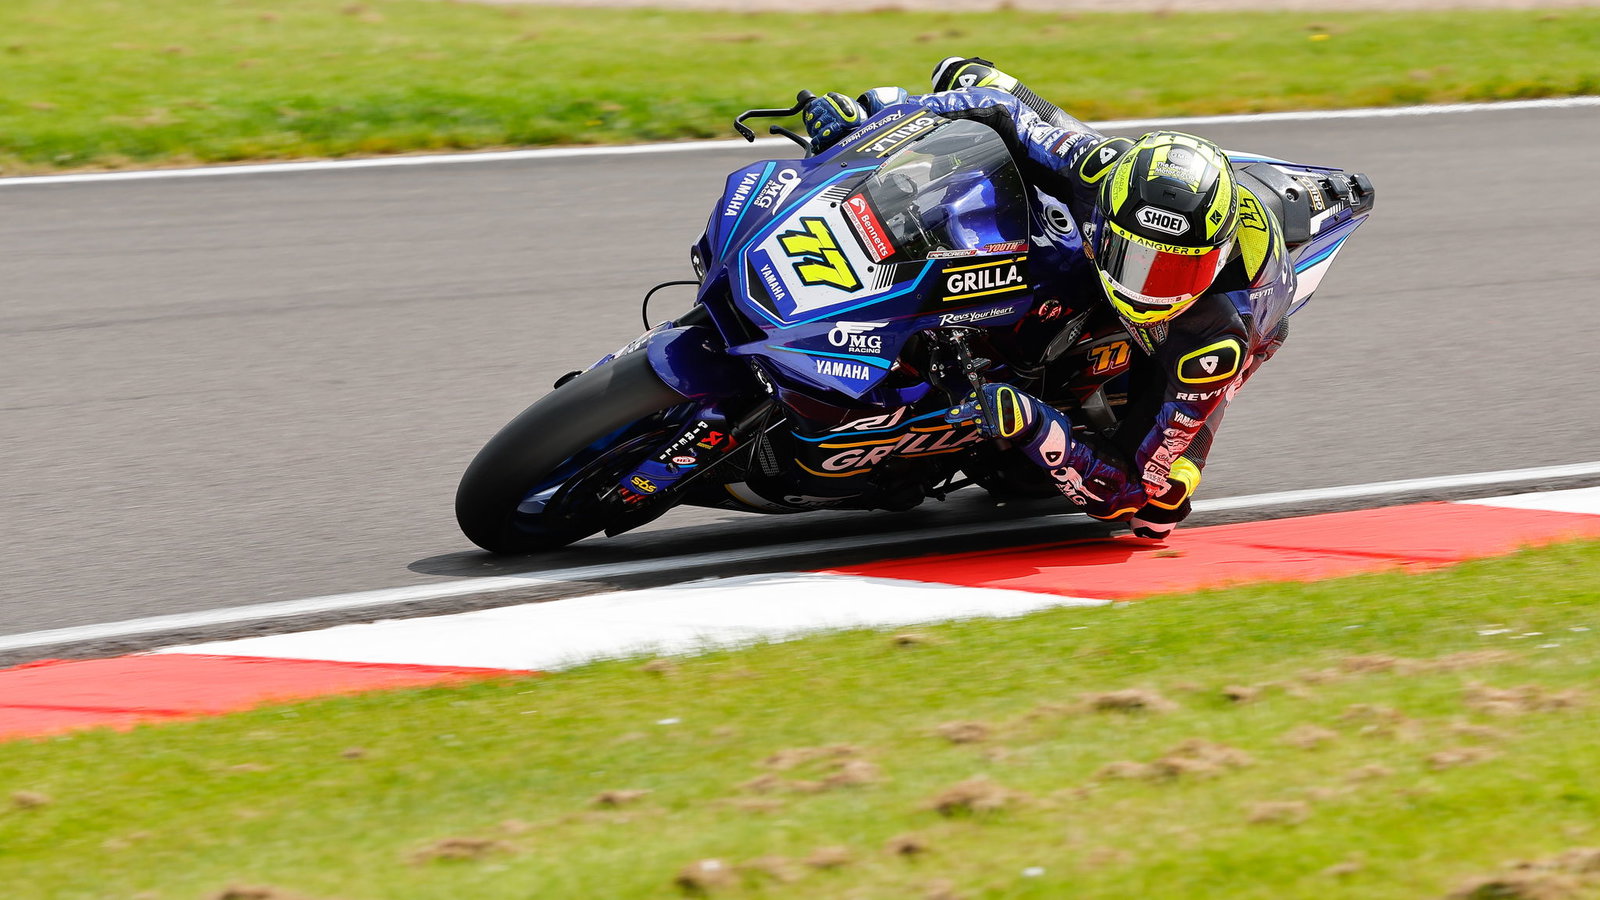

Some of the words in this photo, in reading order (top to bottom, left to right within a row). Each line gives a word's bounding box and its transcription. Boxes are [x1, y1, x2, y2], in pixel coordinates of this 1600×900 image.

[724, 173, 760, 216] YAMAHA
[754, 180, 773, 206] RACING
[760, 169, 799, 209] OMG
[1143, 211, 1184, 231] SHOEI
[861, 214, 889, 257] Bennetts
[1129, 235, 1189, 255] LANGVER
[777, 216, 864, 293] 77
[760, 264, 786, 301] YAMAHA
[947, 265, 1023, 293] GRILLA.
[828, 327, 882, 349] OMG
[816, 359, 870, 381] YAMAHA
[1088, 341, 1131, 373] 77
[830, 406, 907, 432] R1
[631, 476, 657, 493] sbs
